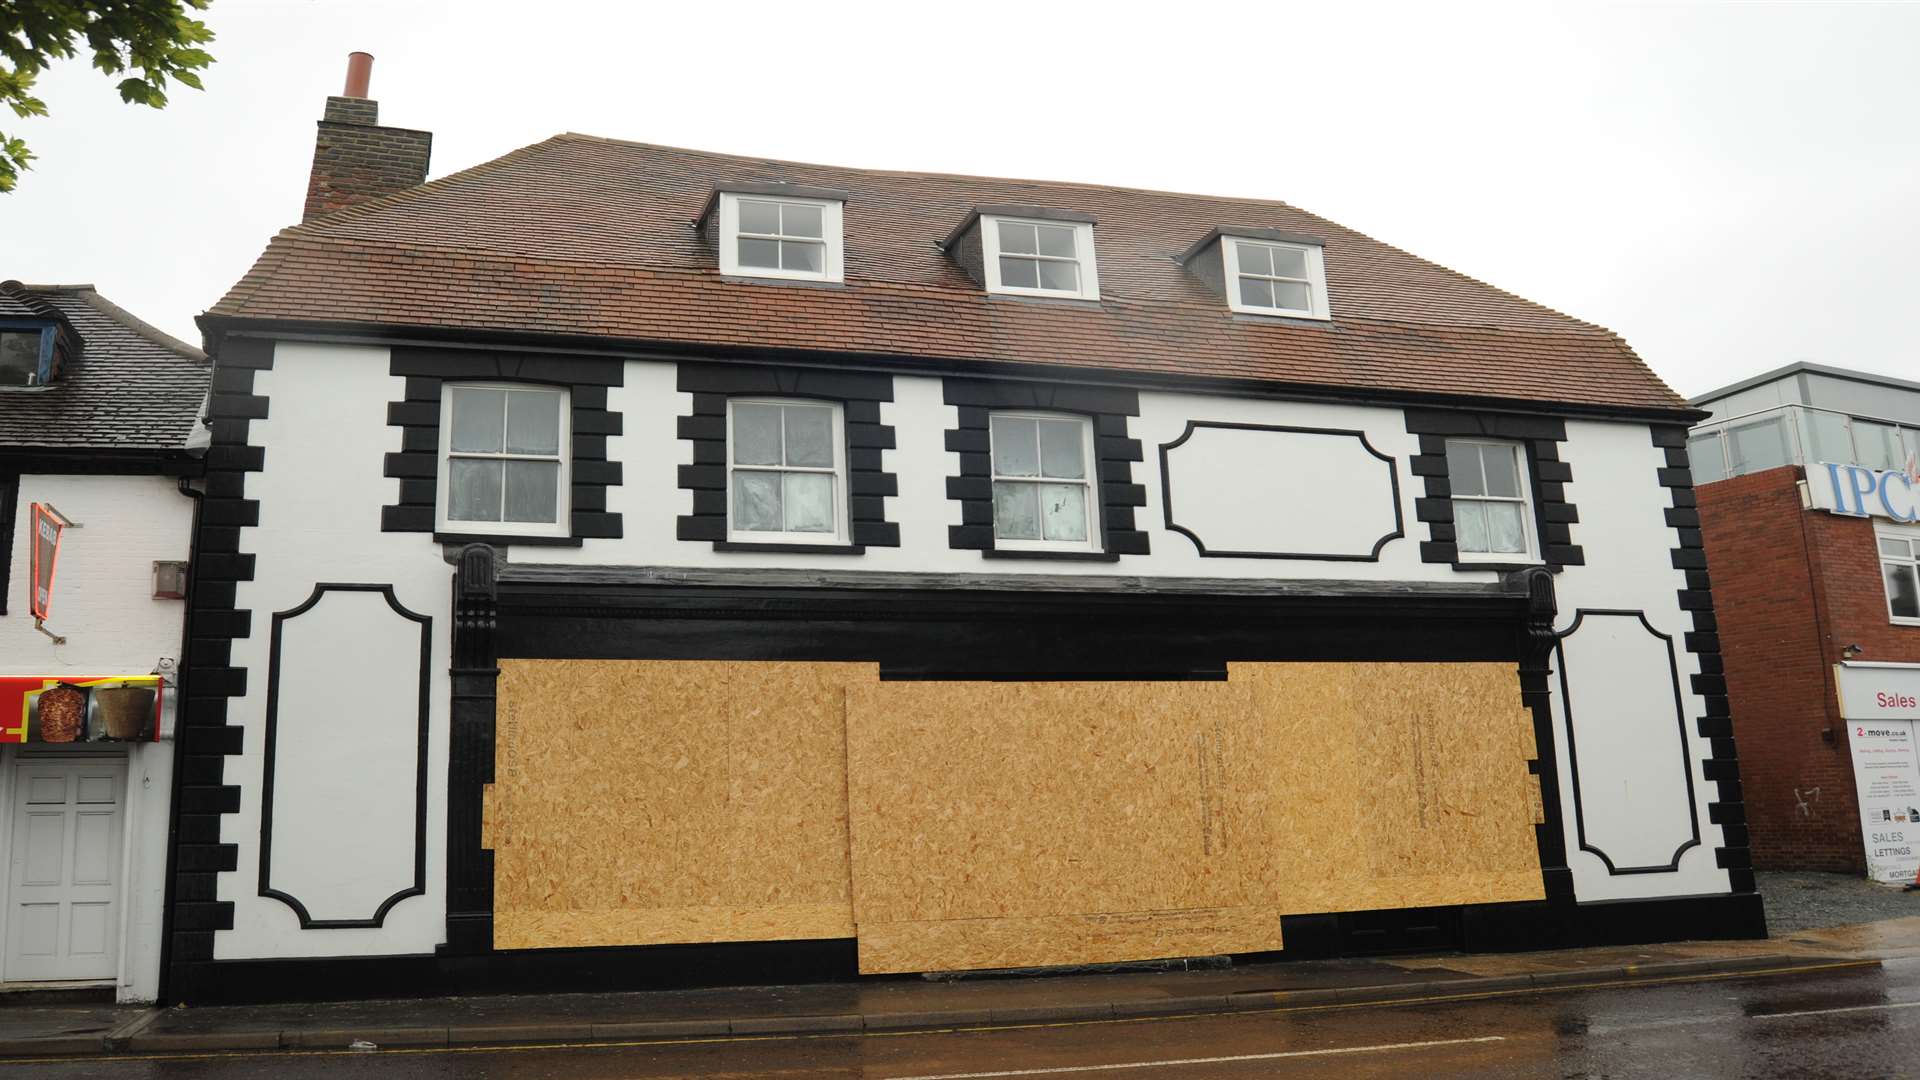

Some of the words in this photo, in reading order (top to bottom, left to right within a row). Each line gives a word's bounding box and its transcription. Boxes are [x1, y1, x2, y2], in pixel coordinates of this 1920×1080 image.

[1827, 464, 1916, 522] IPC
[1877, 692, 1916, 708] Sales
[1871, 831, 1904, 844] SALES
[1874, 846, 1911, 857] LETTINGS
